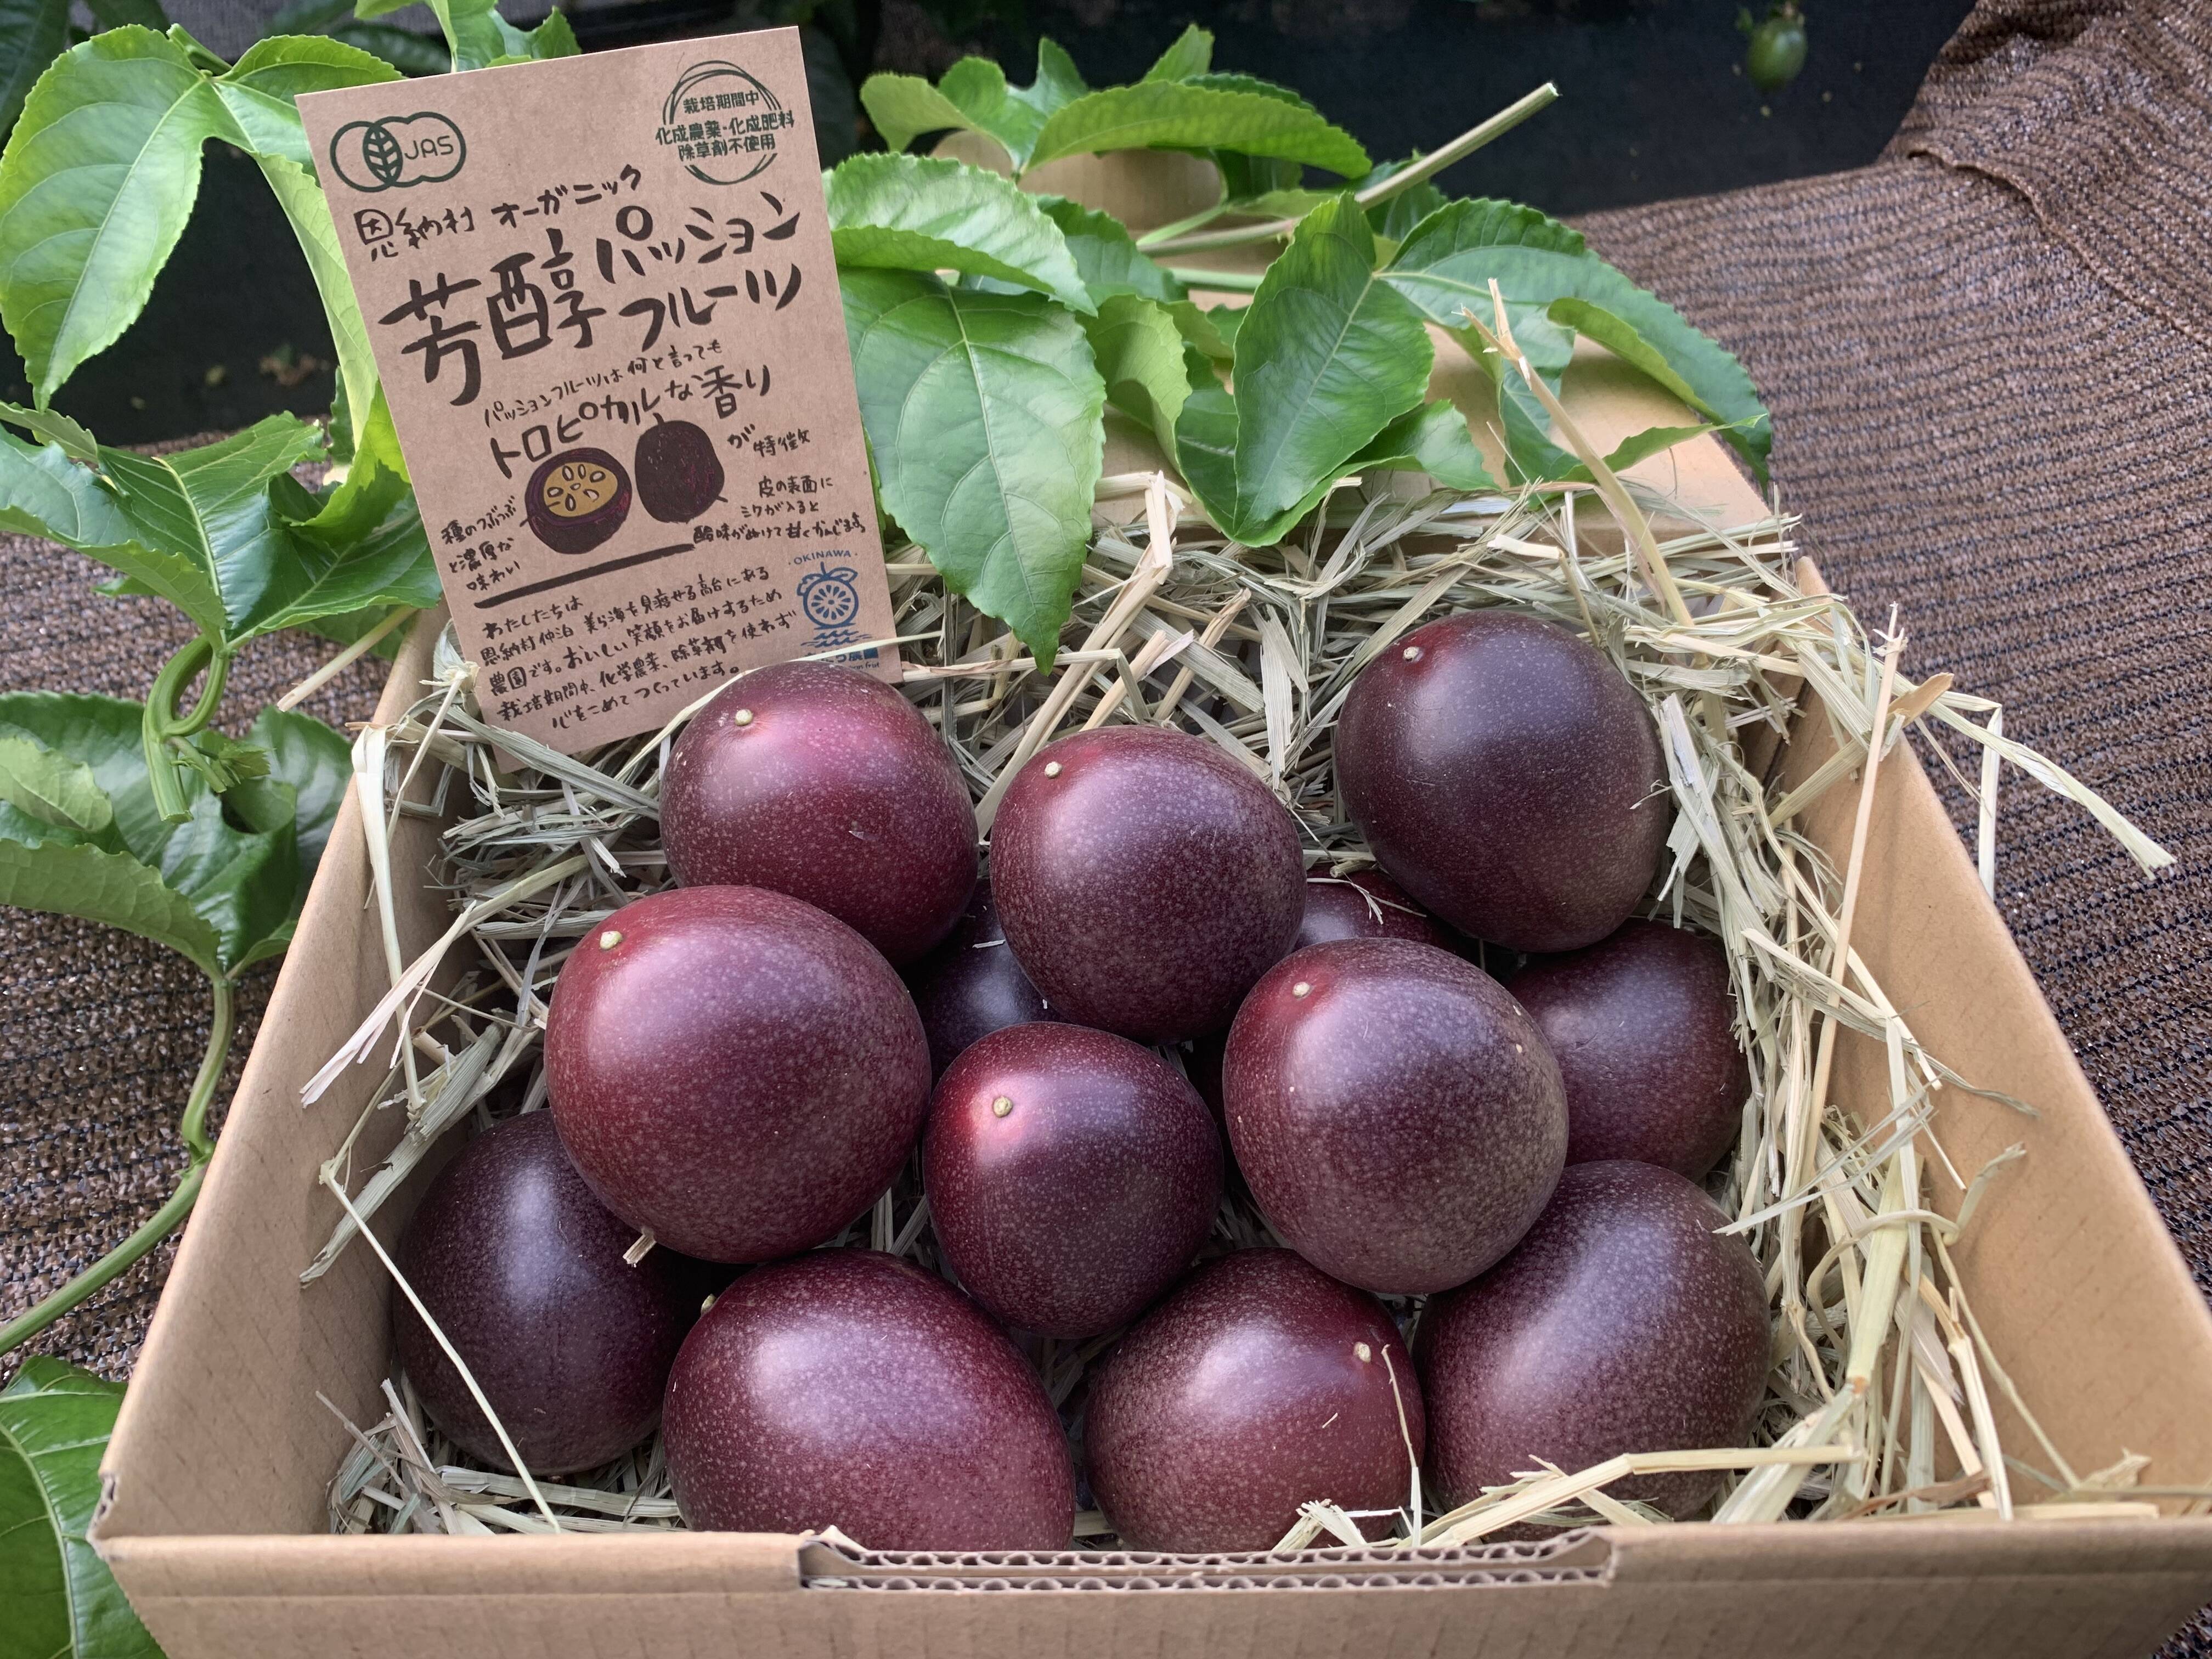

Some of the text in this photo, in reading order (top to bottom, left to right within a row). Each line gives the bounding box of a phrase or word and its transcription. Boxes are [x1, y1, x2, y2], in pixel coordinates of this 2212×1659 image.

[683, 91, 759, 114] 栽培期間中
[404, 135, 453, 160] JAS
[678, 133, 776, 161] 除草剤不使用
[353, 165, 641, 261] 恩納村 オーガニック
[596, 191, 801, 284] パッション
[379, 228, 606, 406] 芳醇
[618, 263, 802, 352] フルーツ
[490, 365, 770, 478] トロピカルな香り
[759, 475, 833, 498] 皮の表面に
[449, 537, 514, 573] と濃厚な
[794, 550, 851, 565] OKINAWA
[466, 561, 520, 590] 味わい
[482, 595, 583, 640] わたしたちは
